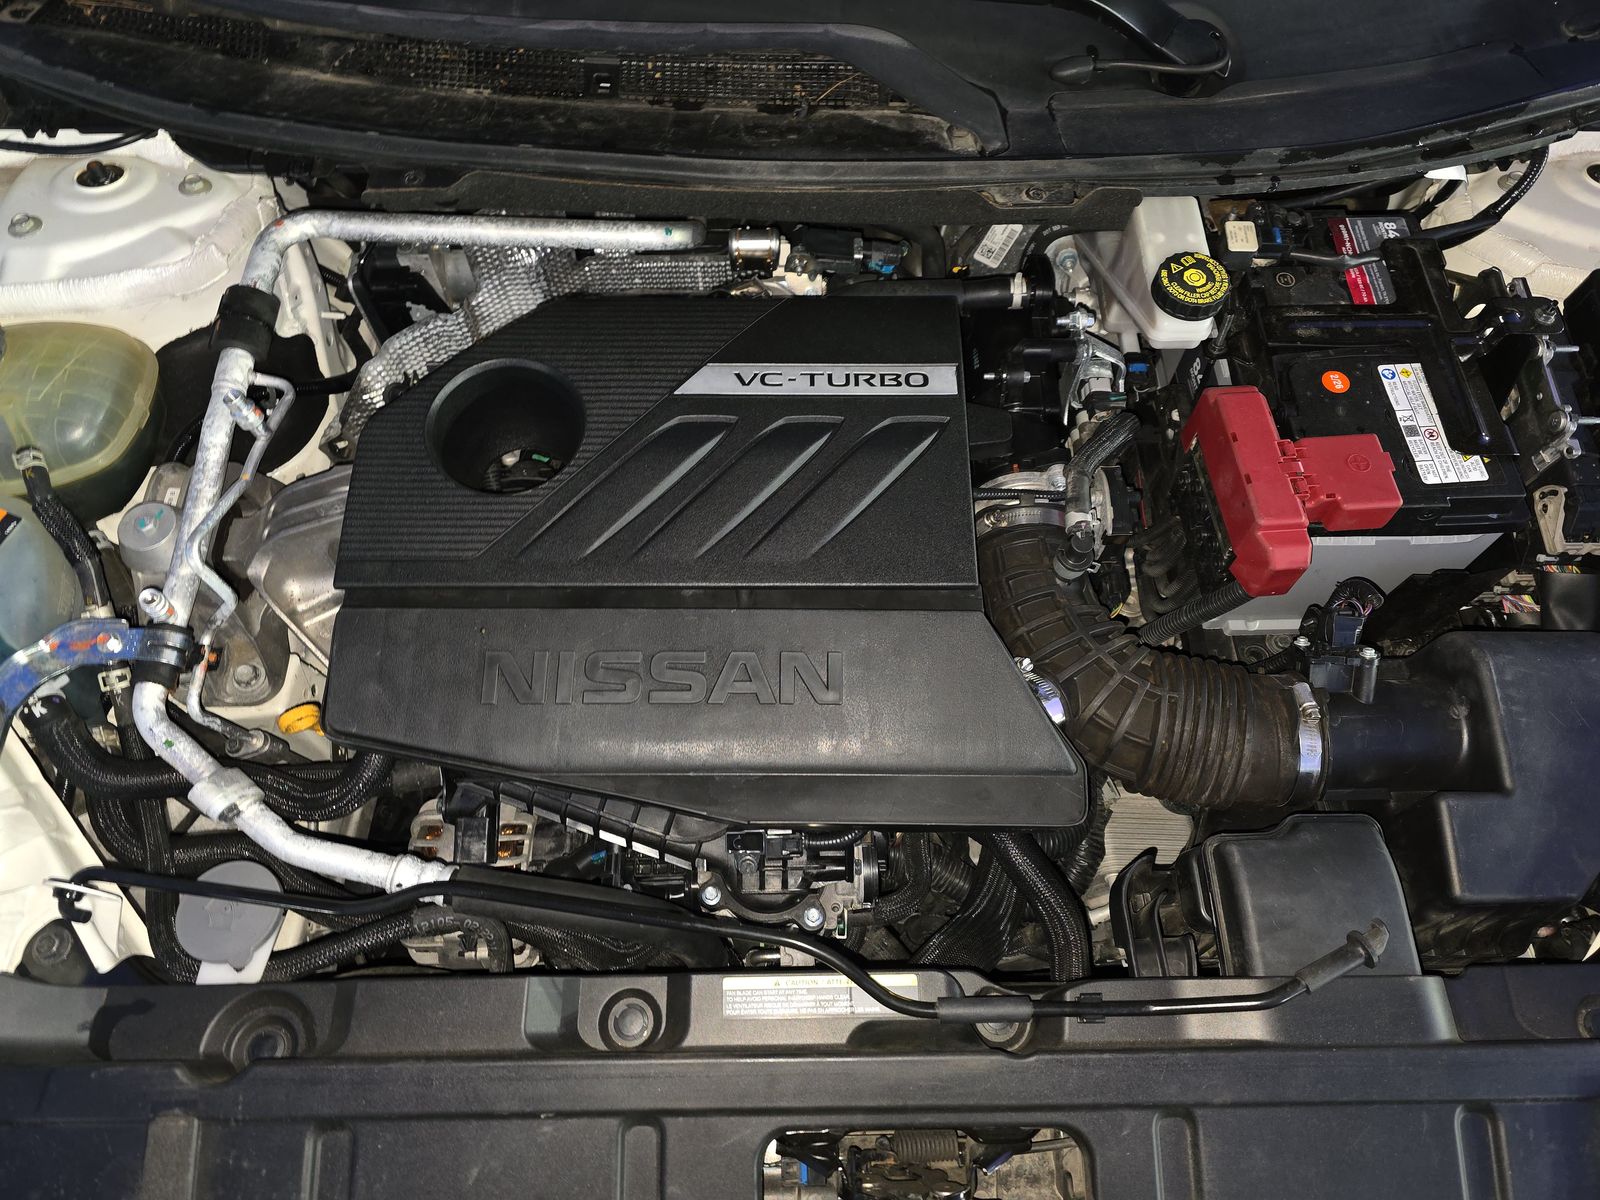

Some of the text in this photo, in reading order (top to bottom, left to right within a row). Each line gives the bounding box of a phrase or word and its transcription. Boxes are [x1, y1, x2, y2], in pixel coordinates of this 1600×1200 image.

[1382, 222, 1400, 238] 84
[734, 372, 929, 387] VC-TURBO
[1330, 374, 1344, 389] 2/26
[480, 651, 843, 705] NISSAN
